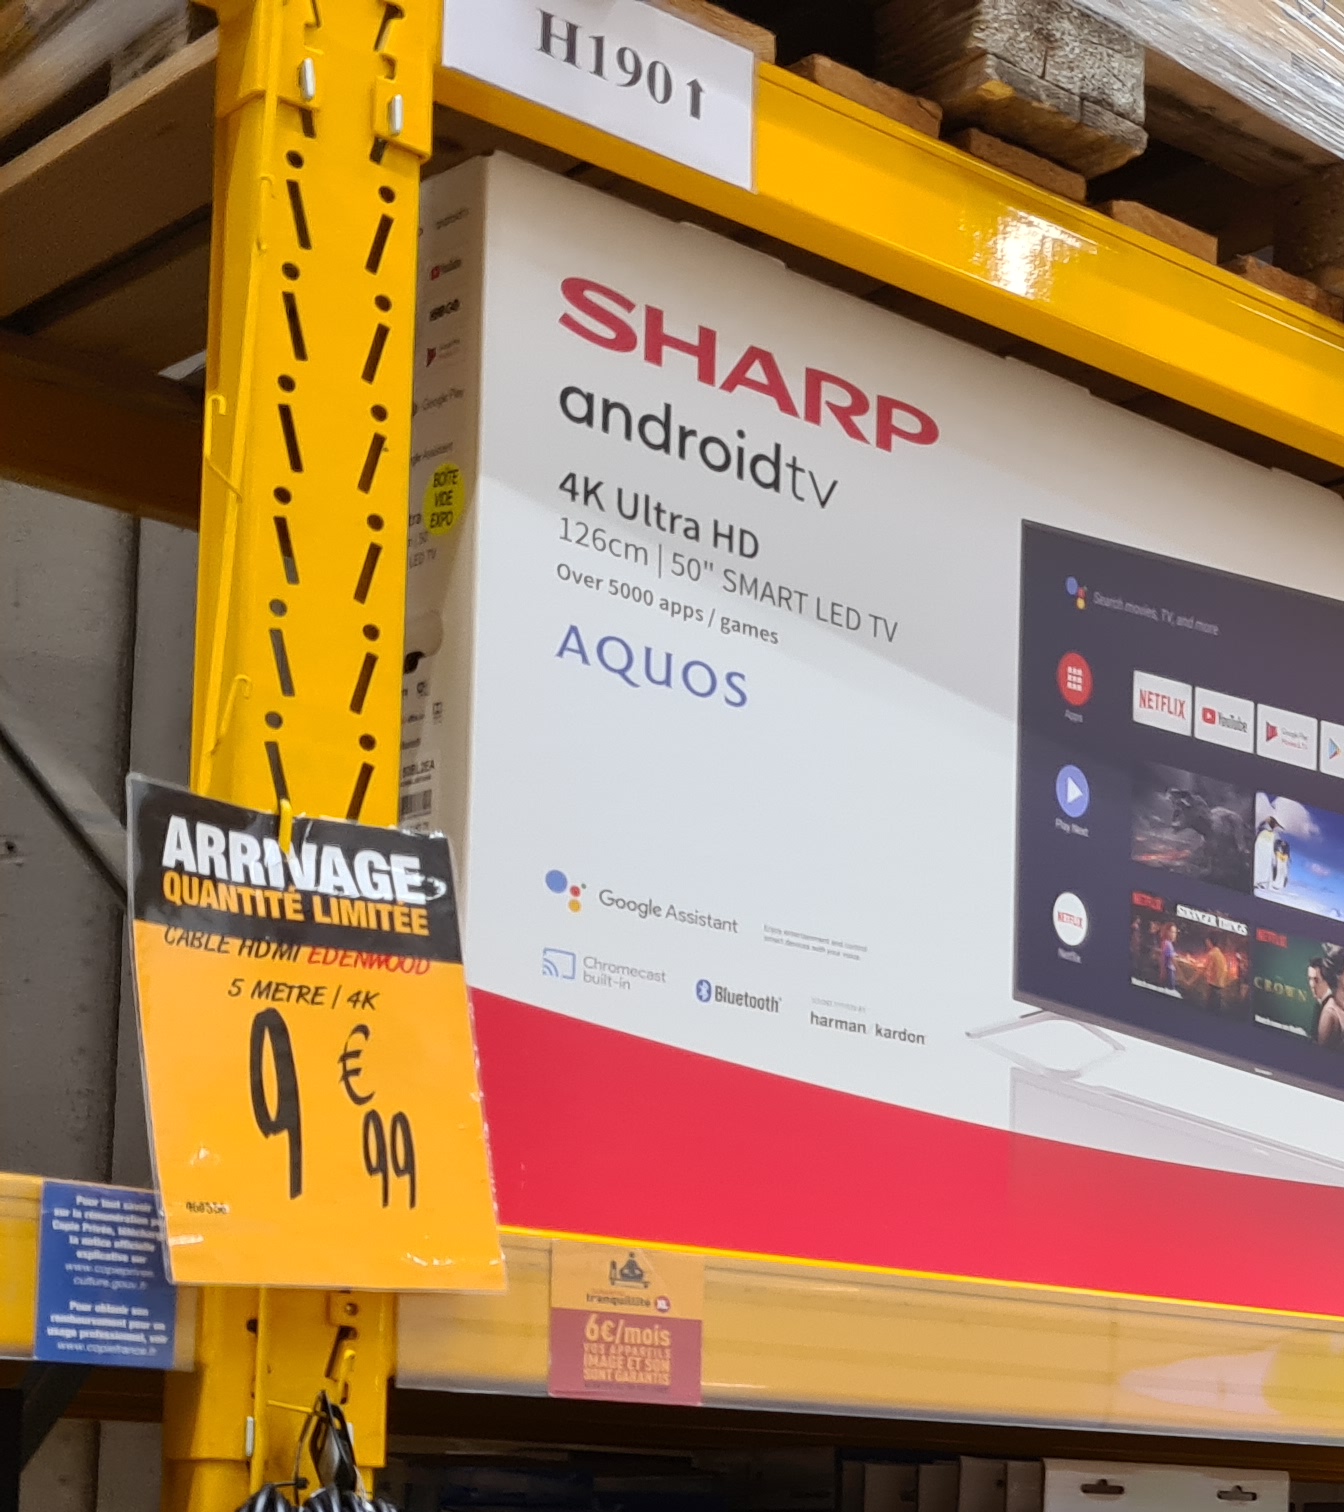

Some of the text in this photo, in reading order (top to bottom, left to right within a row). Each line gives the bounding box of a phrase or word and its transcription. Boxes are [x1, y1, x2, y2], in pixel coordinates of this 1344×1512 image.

[536, 10, 672, 107] H190
[558, 276, 940, 452] SHARP
[560, 385, 838, 509] androidtv
[559, 471, 759, 559] 4K Ultra HD
[557, 562, 779, 645] Over 5000 apps games
[559, 517, 899, 643] 126cm 50" SMART LED TV
[556, 625, 749, 708] AQUOS
[1139, 688, 1186, 721] NETFLIX
[1217, 710, 1248, 734] YouTube
[162, 815, 426, 905] ARRIVAGE
[162, 871, 304, 923] QUANTITÉ
[599, 889, 738, 933] Google Assistant
[164, 924, 432, 977] CABLE HDMI EDENWOOD
[583, 956, 666, 983] Chromecast
[583, 971, 631, 991] built-in
[227, 978, 380, 1011] 5 METRE 4K
[715, 986, 780, 1013] Bluetooth
[810, 1011, 925, 1045] harman kardon
[338, 1023, 377, 1106] €
[250, 1006, 303, 1200] 9
[362, 1109, 417, 1210] 99
[585, 1314, 671, 1346] 6€/mois
